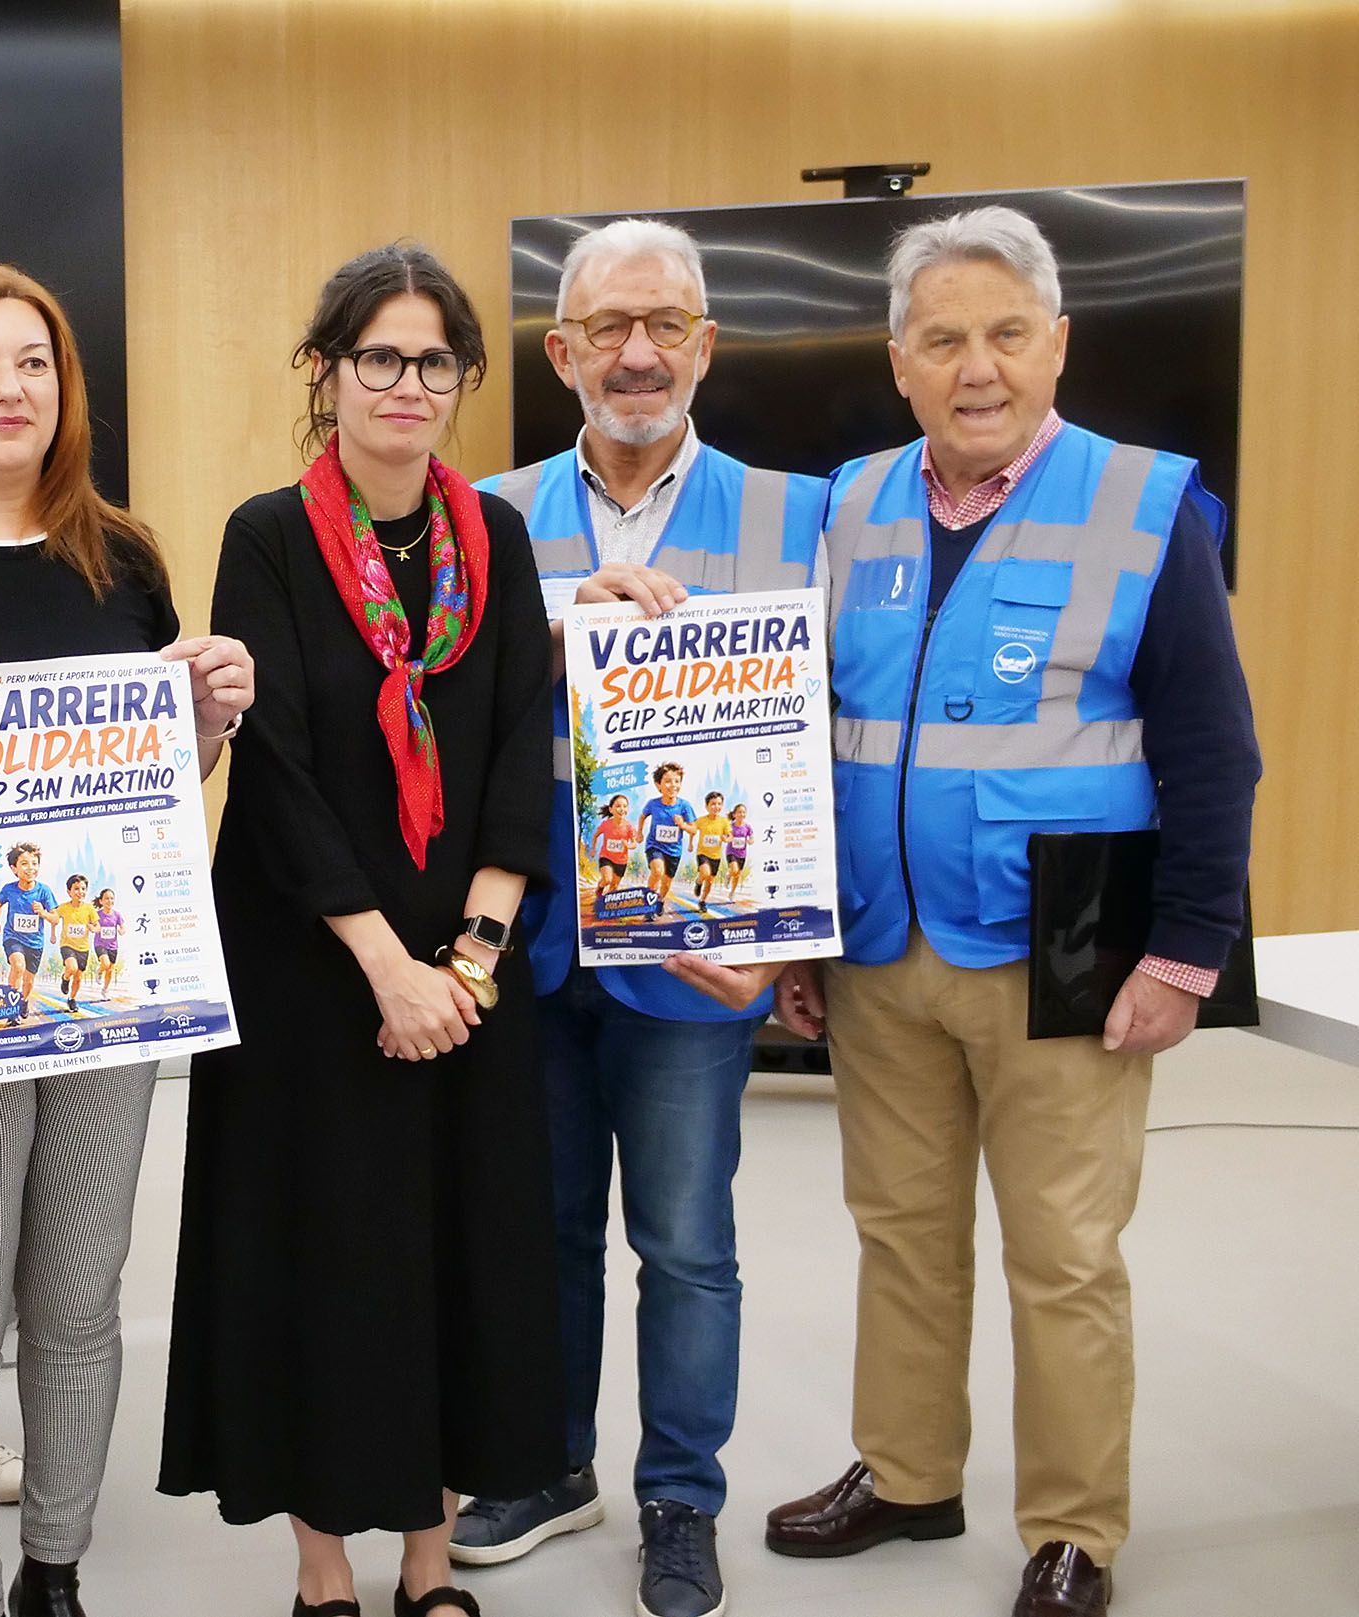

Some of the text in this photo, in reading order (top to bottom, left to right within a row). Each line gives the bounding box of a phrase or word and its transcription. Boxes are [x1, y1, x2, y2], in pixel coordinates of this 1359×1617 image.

[589, 614, 811, 670] V CARREIRA
[6, 674, 26, 684] PERO
[28, 672, 58, 682] MÓVETE
[60, 673, 65, 681] E
[66, 671, 95, 680] APORTA
[96, 670, 116, 678] POLO
[117, 668, 133, 678] QUE
[133, 666, 168, 675] IMPORTA
[599, 656, 796, 710] SOLIDARIA
[605, 691, 805, 735] CEIP SAN MARTIÑO
[15, 777, 63, 805] SAN
[70, 764, 175, 798] MARTIÑO
[17, 918, 38, 928] 1234
[6, 1063, 36, 1074] BANCO
[40, 1061, 49, 1070] DE
[53, 1054, 102, 1068] ALIMENTOS
